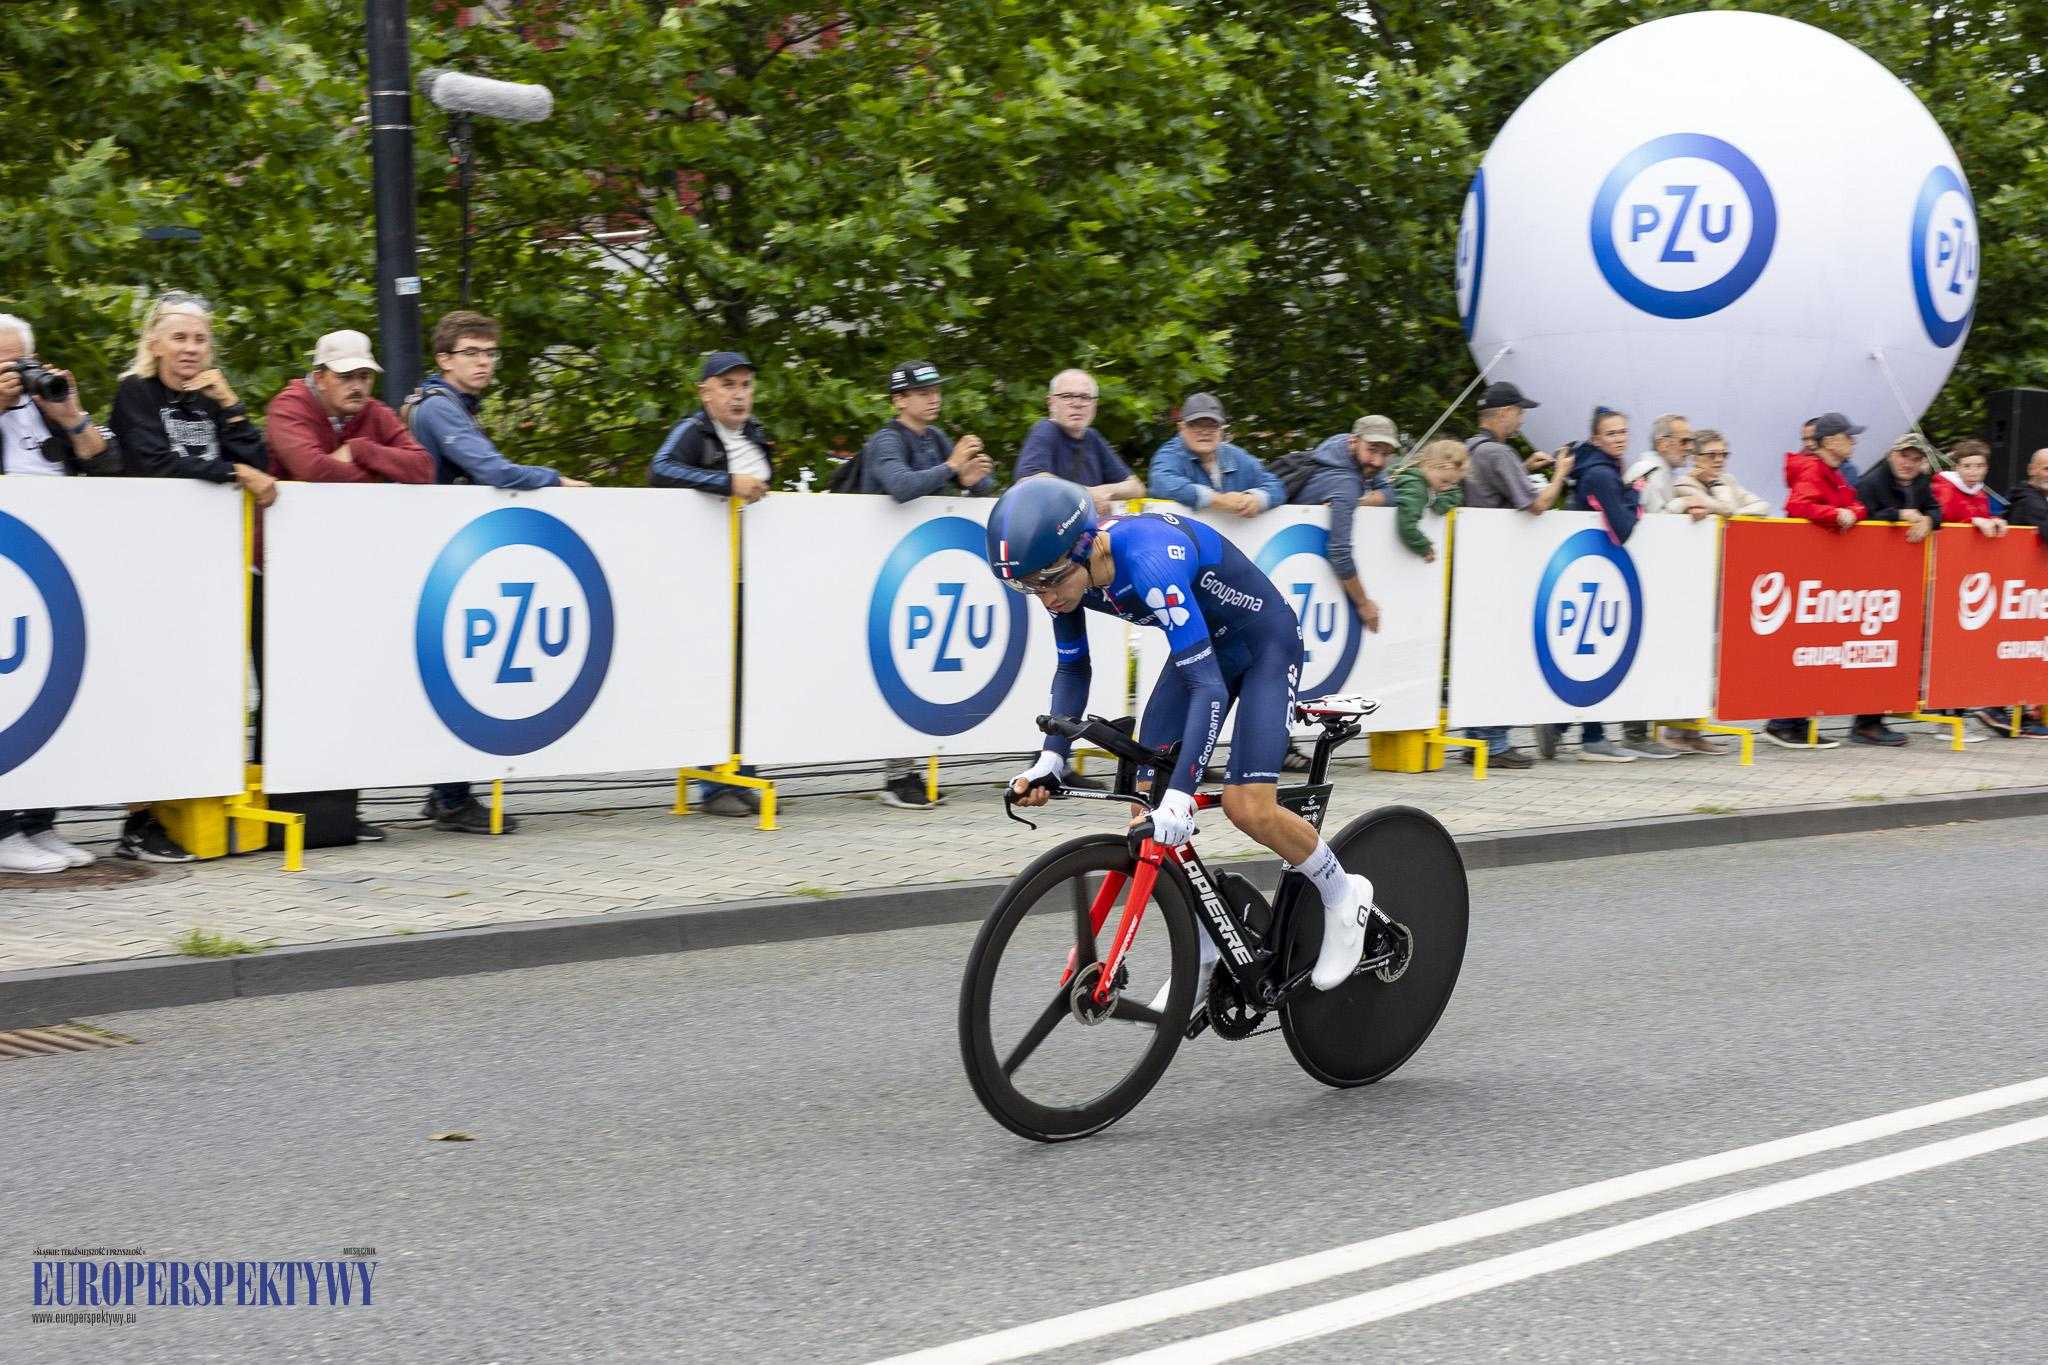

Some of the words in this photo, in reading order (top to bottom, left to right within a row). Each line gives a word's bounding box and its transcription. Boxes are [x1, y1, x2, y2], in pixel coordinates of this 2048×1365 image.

[1631, 185, 1733, 263] PZU
[907, 582, 995, 672] PZU
[1200, 570, 1264, 612] Groupama
[1290, 582, 1336, 663] ZU
[1558, 582, 1622, 656] PZU
[1795, 580, 1901, 636] Energa
[2000, 579, 2048, 620] Ene
[463, 582, 571, 684] PZU
[1199, 701, 1220, 765] Groupama
[1174, 844, 1254, 966] LAPIERRE
